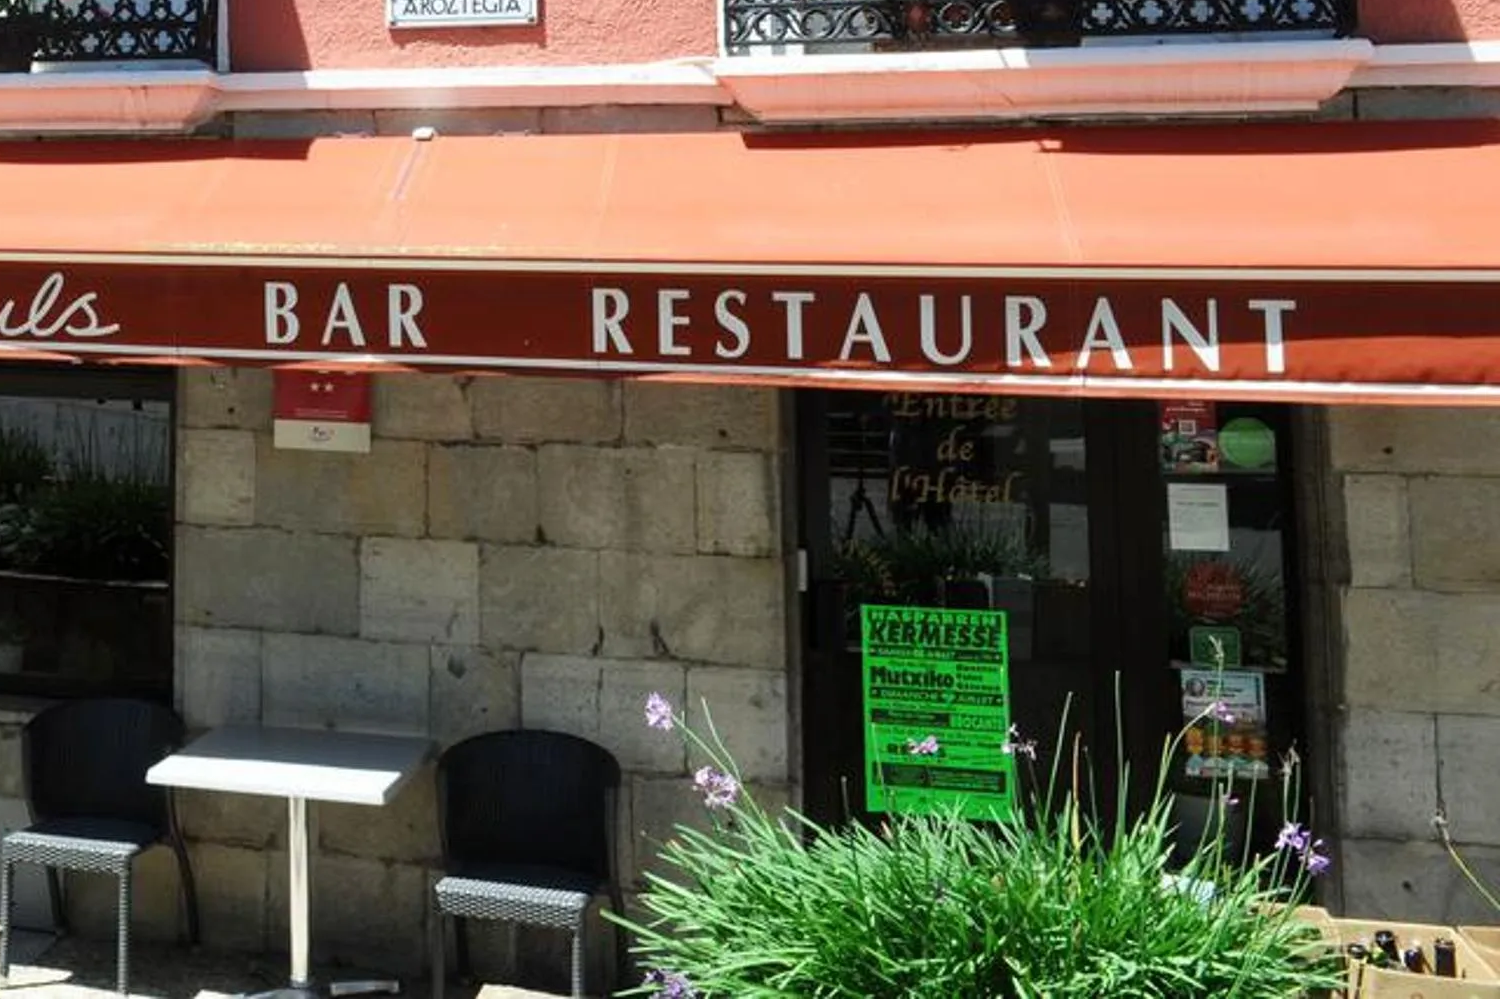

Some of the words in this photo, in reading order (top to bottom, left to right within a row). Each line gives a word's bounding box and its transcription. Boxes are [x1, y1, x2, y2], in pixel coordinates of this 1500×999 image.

[263, 281, 428, 348] BAR
[591, 287, 1296, 373] RESTAURANT
[937, 424, 975, 461] de
[869, 620, 1002, 648] KERMESSE
